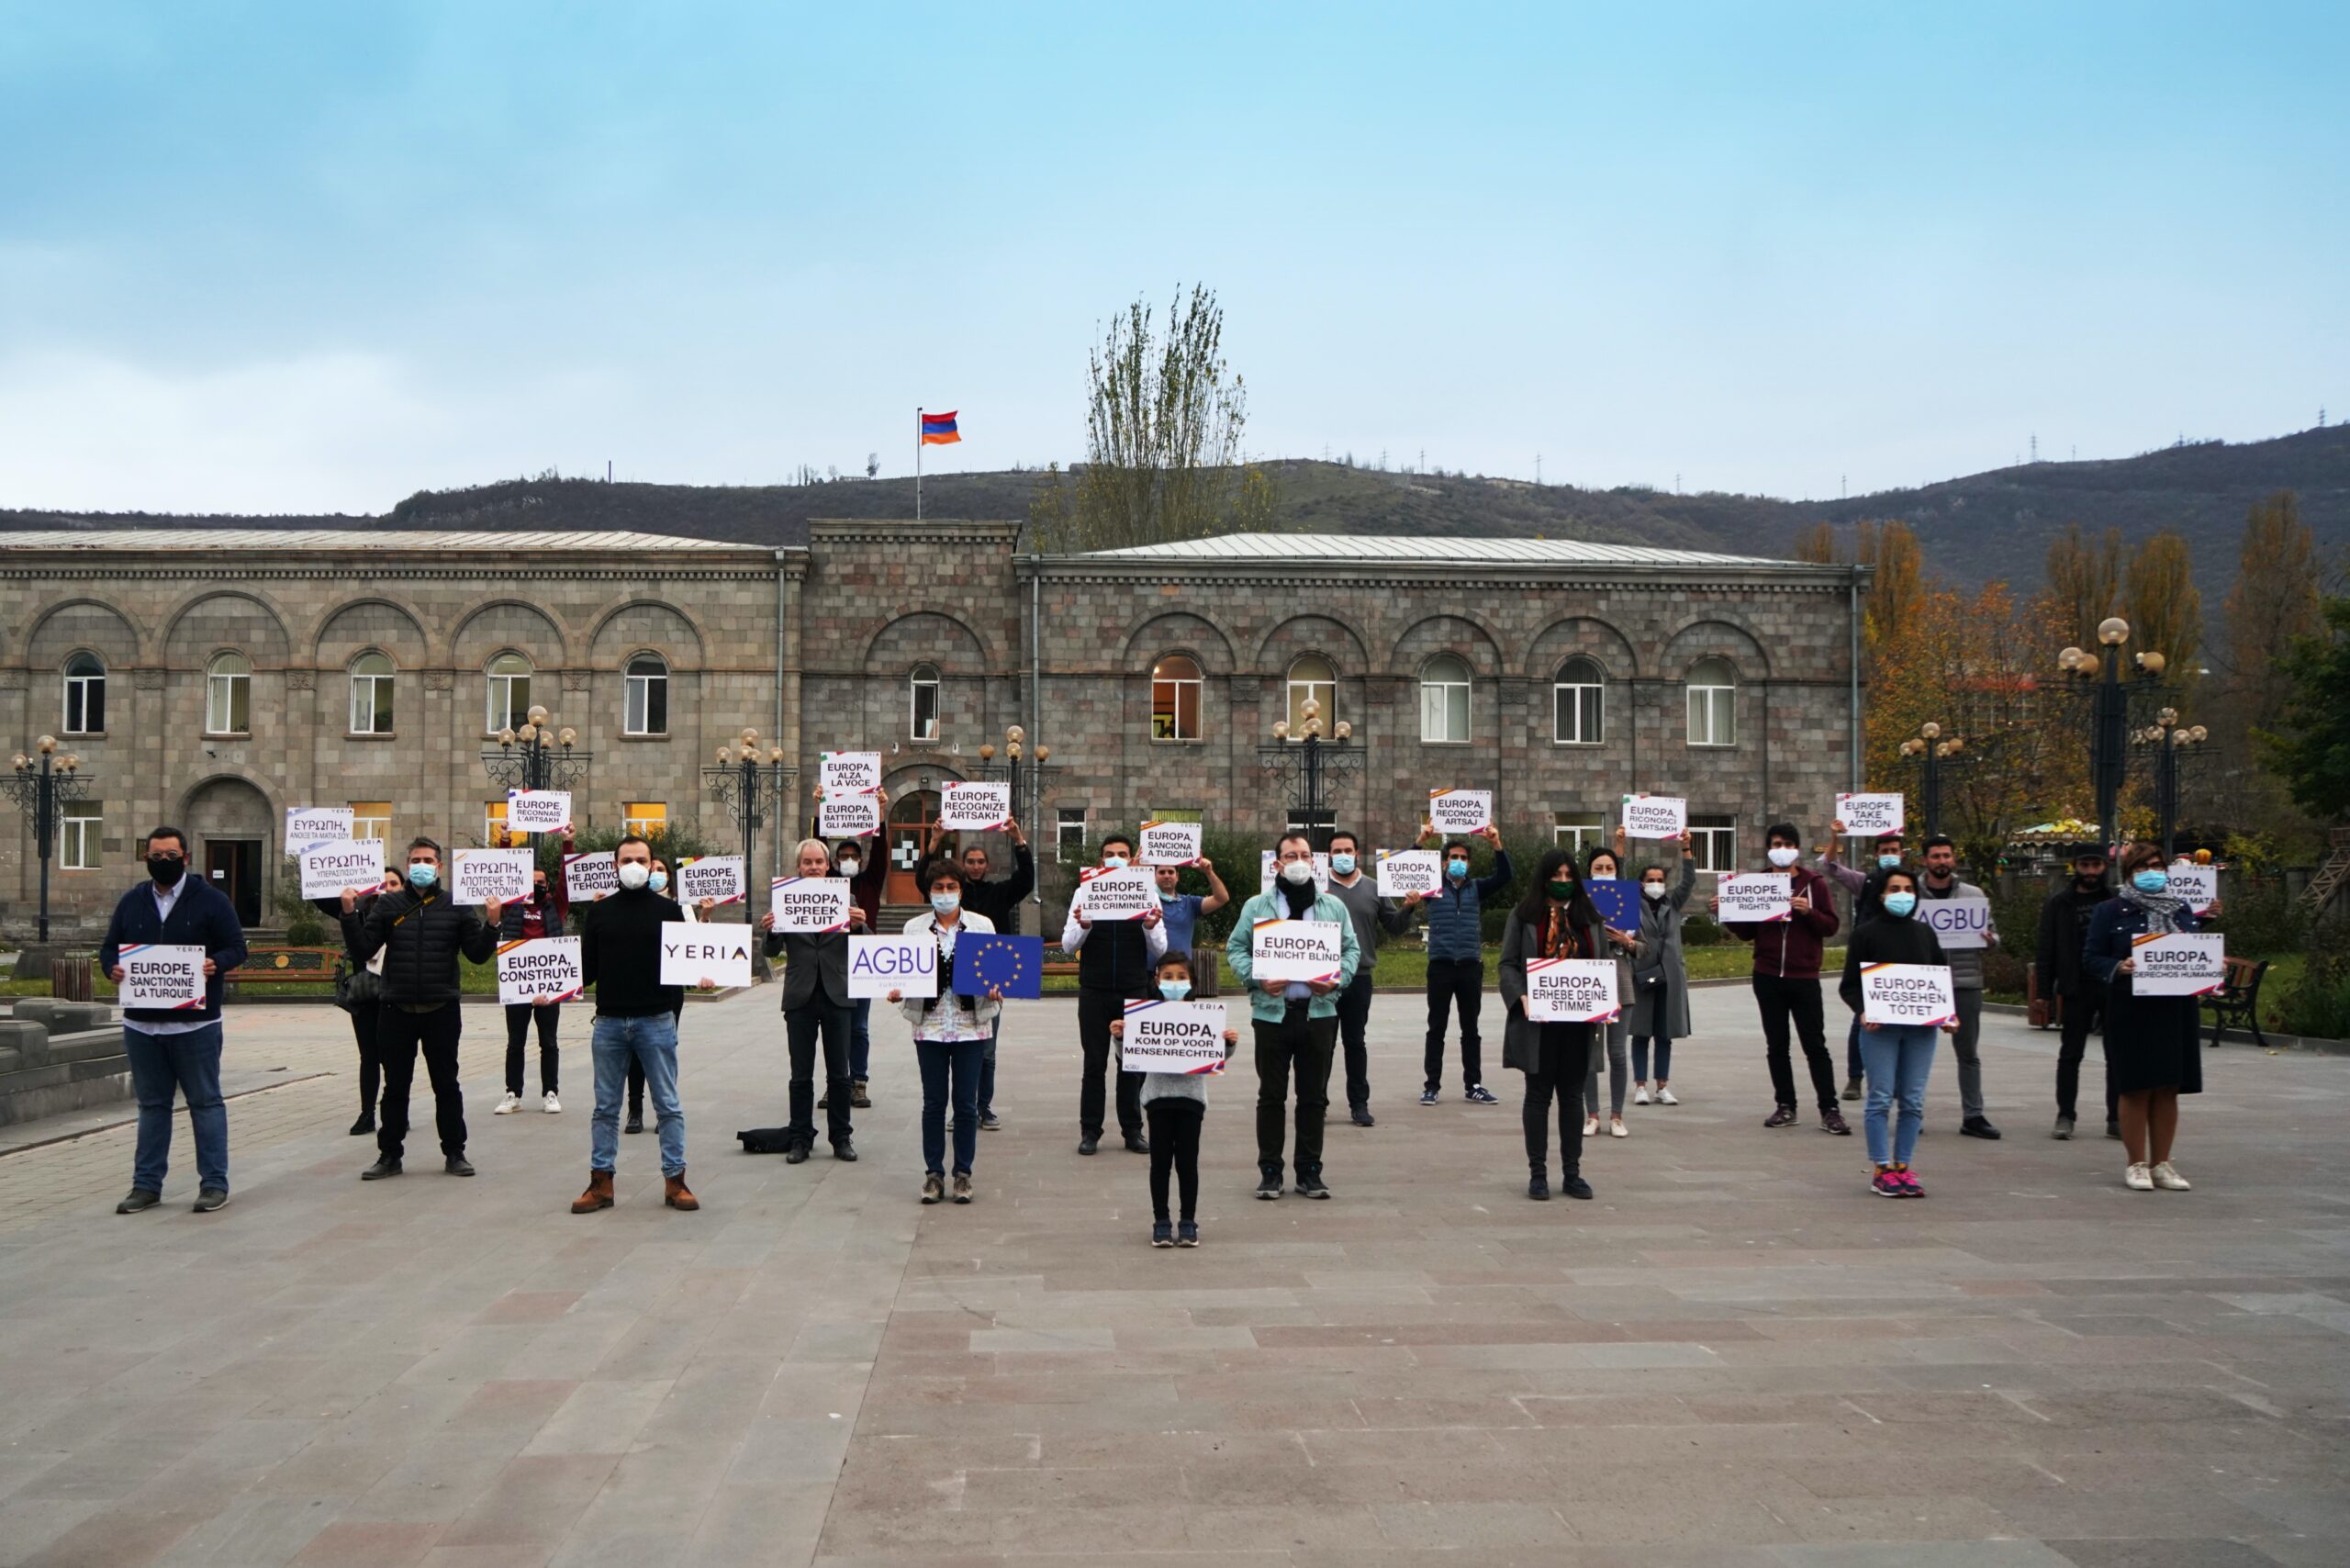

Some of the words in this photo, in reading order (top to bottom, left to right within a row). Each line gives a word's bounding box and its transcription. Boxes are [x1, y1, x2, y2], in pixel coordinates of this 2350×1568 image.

[827, 763, 873, 772] EUROPA,
[950, 791, 1001, 803] EUROPE,
[517, 800, 563, 811] EUROPE,
[826, 805, 871, 814] EUROPA,
[945, 801, 1005, 812] RECOGNIZE
[1438, 800, 1483, 810] EUROPA,
[1845, 801, 1894, 812] EUROPE,
[518, 809, 561, 817] RECONNAIS
[950, 812, 999, 821] ARTSAKH
[1437, 810, 1484, 818] RECONOCE
[1630, 806, 1676, 817] EUROPA,
[1854, 811, 1882, 819] TAKE
[1629, 815, 1677, 824] RICONOSCI
[1849, 820, 1891, 828] ACTION
[295, 820, 346, 832] ΕΥΡΩΠΗ,
[1147, 832, 1192, 843] EUROPA,
[1148, 842, 1192, 850] SANCIONA
[310, 854, 375, 869] ΕΥΡΩΠΗ,
[574, 861, 614, 872] ЕВРОП
[464, 862, 522, 876] ΕΥΡΩΠΗ,
[686, 868, 735, 879] EUROPE,
[1387, 863, 1436, 873] EUROPA,
[507, 876, 523, 885] ΤΗΝ
[568, 874, 581, 882] НЕ
[2165, 877, 2206, 889] ROPA,
[685, 880, 695, 889] NE
[698, 879, 721, 888] RESTE
[722, 879, 736, 887] PAS
[1091, 881, 1147, 893] EUROPE,
[1393, 881, 1430, 890] FOLKMORD
[466, 887, 520, 897] ΓΕΝΟΚΤΟΝΙΑ
[688, 887, 736, 897] SILENCIEUSE
[1728, 885, 1781, 896] EUROPE,
[784, 894, 843, 905] EUROPA,
[1088, 893, 1147, 902] SANCTIONNE
[785, 906, 838, 915] SPREEK
[1102, 902, 1153, 910] CRIMINELS
[792, 916, 809, 925] JE
[813, 916, 834, 924] UIT
[1919, 908, 1986, 931] AGBU
[1264, 936, 1330, 953] EUROPA,
[665, 944, 748, 960] YERIA
[1254, 949, 1270, 958] SEI
[1273, 950, 1304, 960] NICHT
[1309, 951, 1339, 962] BLIND
[509, 955, 571, 969] EUROPA,
[852, 946, 934, 974] AGBU
[2144, 951, 2212, 965] EUROPA,
[131, 963, 195, 977] EUROPE,
[499, 968, 578, 982] CONSTRUYE
[130, 977, 195, 988] SANCTIONNE
[1539, 976, 1606, 990] EUROPA,
[1874, 978, 1942, 992] EUROPA,
[134, 988, 147, 998] LA
[150, 988, 194, 999] TURQUIE
[519, 984, 535, 995] LA
[538, 982, 564, 993] PAZ
[1532, 990, 1573, 1000] ERHEBE
[1577, 991, 1607, 1001] DEINE
[1868, 991, 1947, 1003] WEGSEHEN
[1551, 1001, 1592, 1012] STIMME
[1140, 1022, 1216, 1040] EUROPA,
[1135, 1036, 1164, 1046] KOM
[1167, 1037, 1181, 1047] OP
[1182, 1038, 1214, 1047] VOOR
[1125, 1047, 1223, 1058] MENSENRECHTEN
